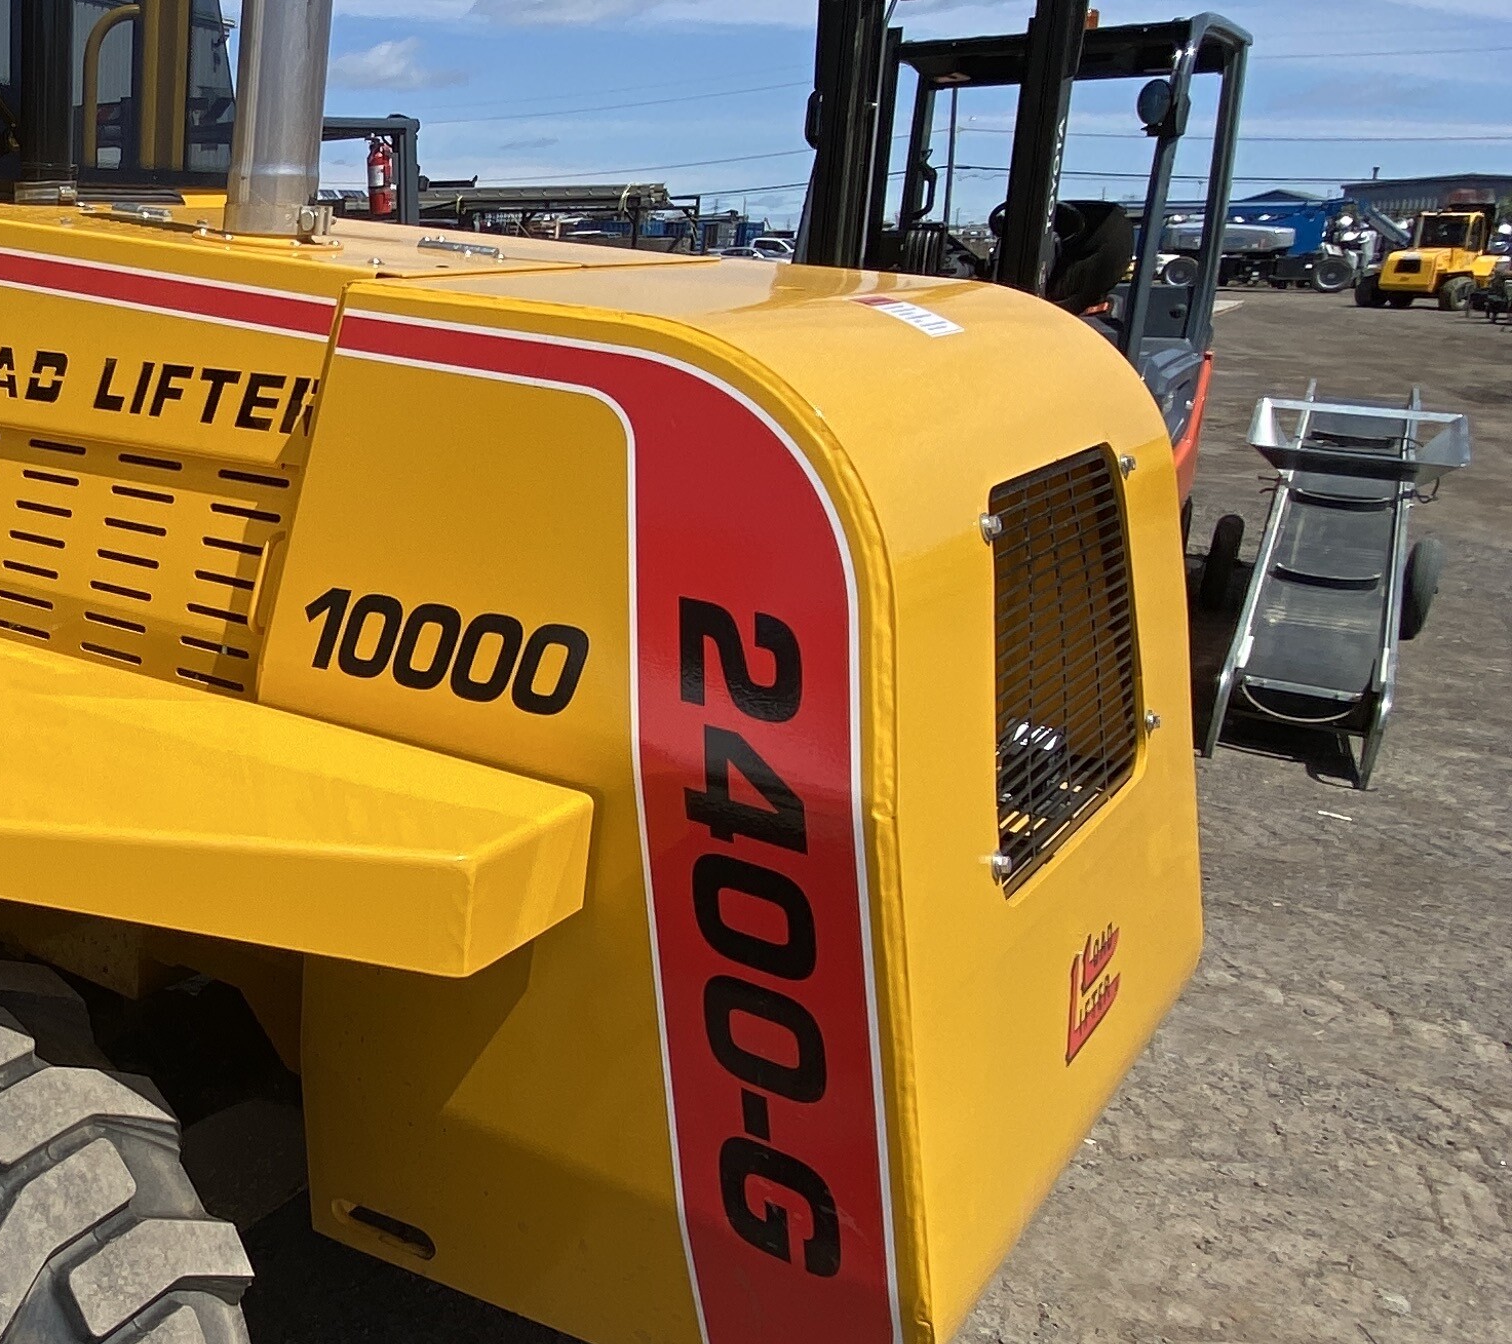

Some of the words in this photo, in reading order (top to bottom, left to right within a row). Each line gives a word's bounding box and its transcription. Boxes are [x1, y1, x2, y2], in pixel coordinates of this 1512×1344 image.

[1044, 117, 1066, 235] TOYOTA
[304, 587, 590, 716] 10000
[679, 595, 842, 1279] 2400-G
